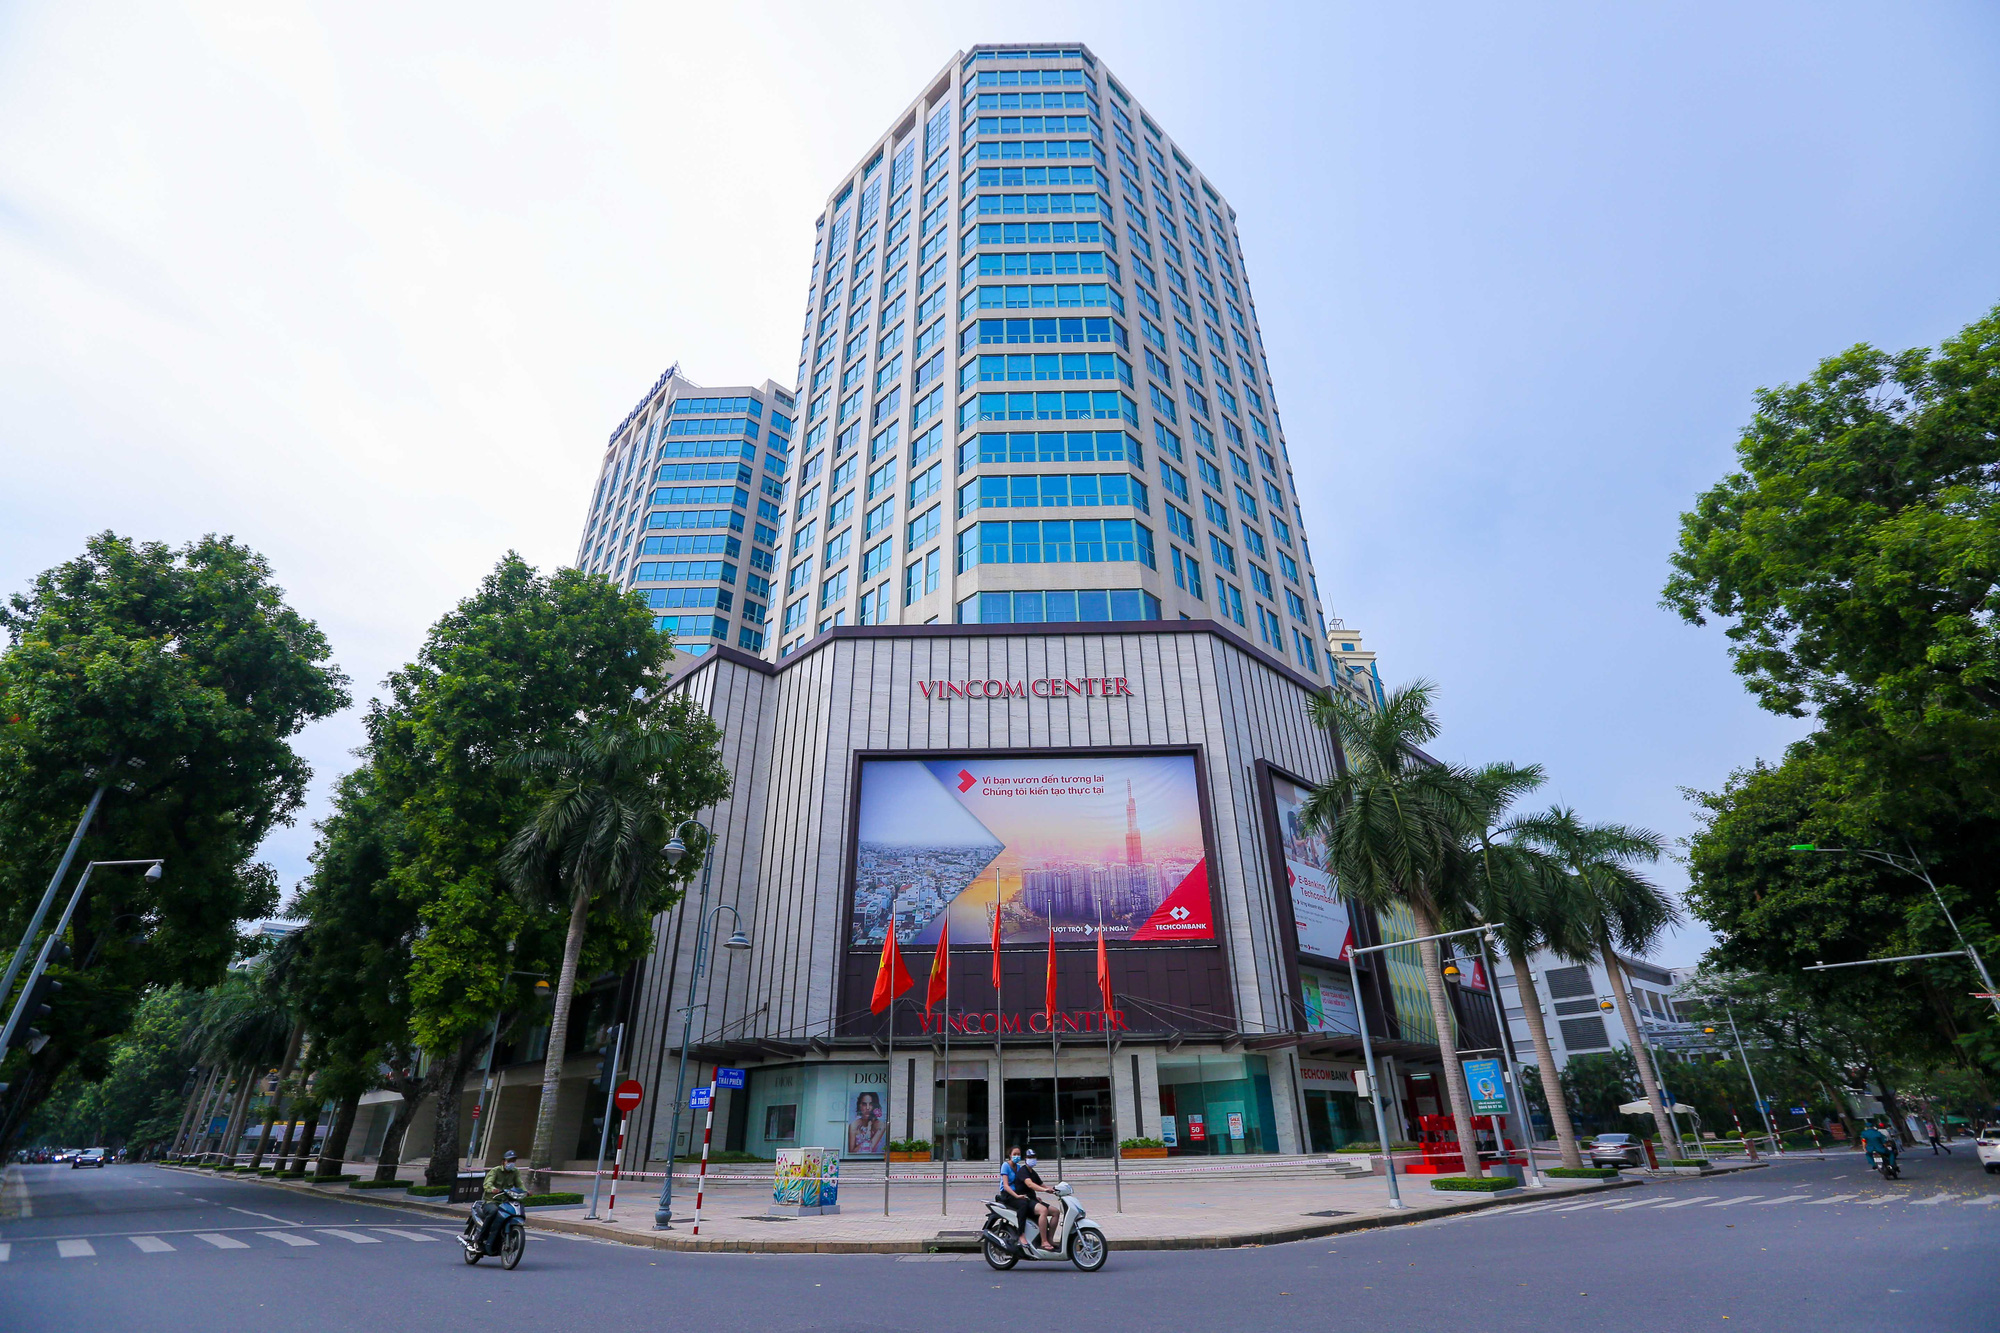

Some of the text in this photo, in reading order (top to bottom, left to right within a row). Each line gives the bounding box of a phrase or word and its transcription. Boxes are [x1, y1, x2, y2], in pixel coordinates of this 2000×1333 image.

[918, 676, 1134, 700] VINCOM CENTER
[993, 776, 1011, 787] bạn
[1012, 777, 1039, 785] vươn
[1041, 774, 1059, 784] đến
[1061, 775, 1092, 785] tương
[1093, 775, 1104, 783] lai
[982, 785, 1105, 798] Chúng tôi kiến tạo thực tại
[1298, 875, 1327, 894] E-Banking
[1109, 924, 1129, 933] NGÀY
[1155, 923, 1207, 931] TECHCOMBANK
[917, 1010, 1131, 1034] VINCOM CENTER
[854, 1072, 888, 1084] DIOR
[1300, 1068, 1349, 1081] TECHCOMBANK
[775, 1076, 793, 1087] DIOR
